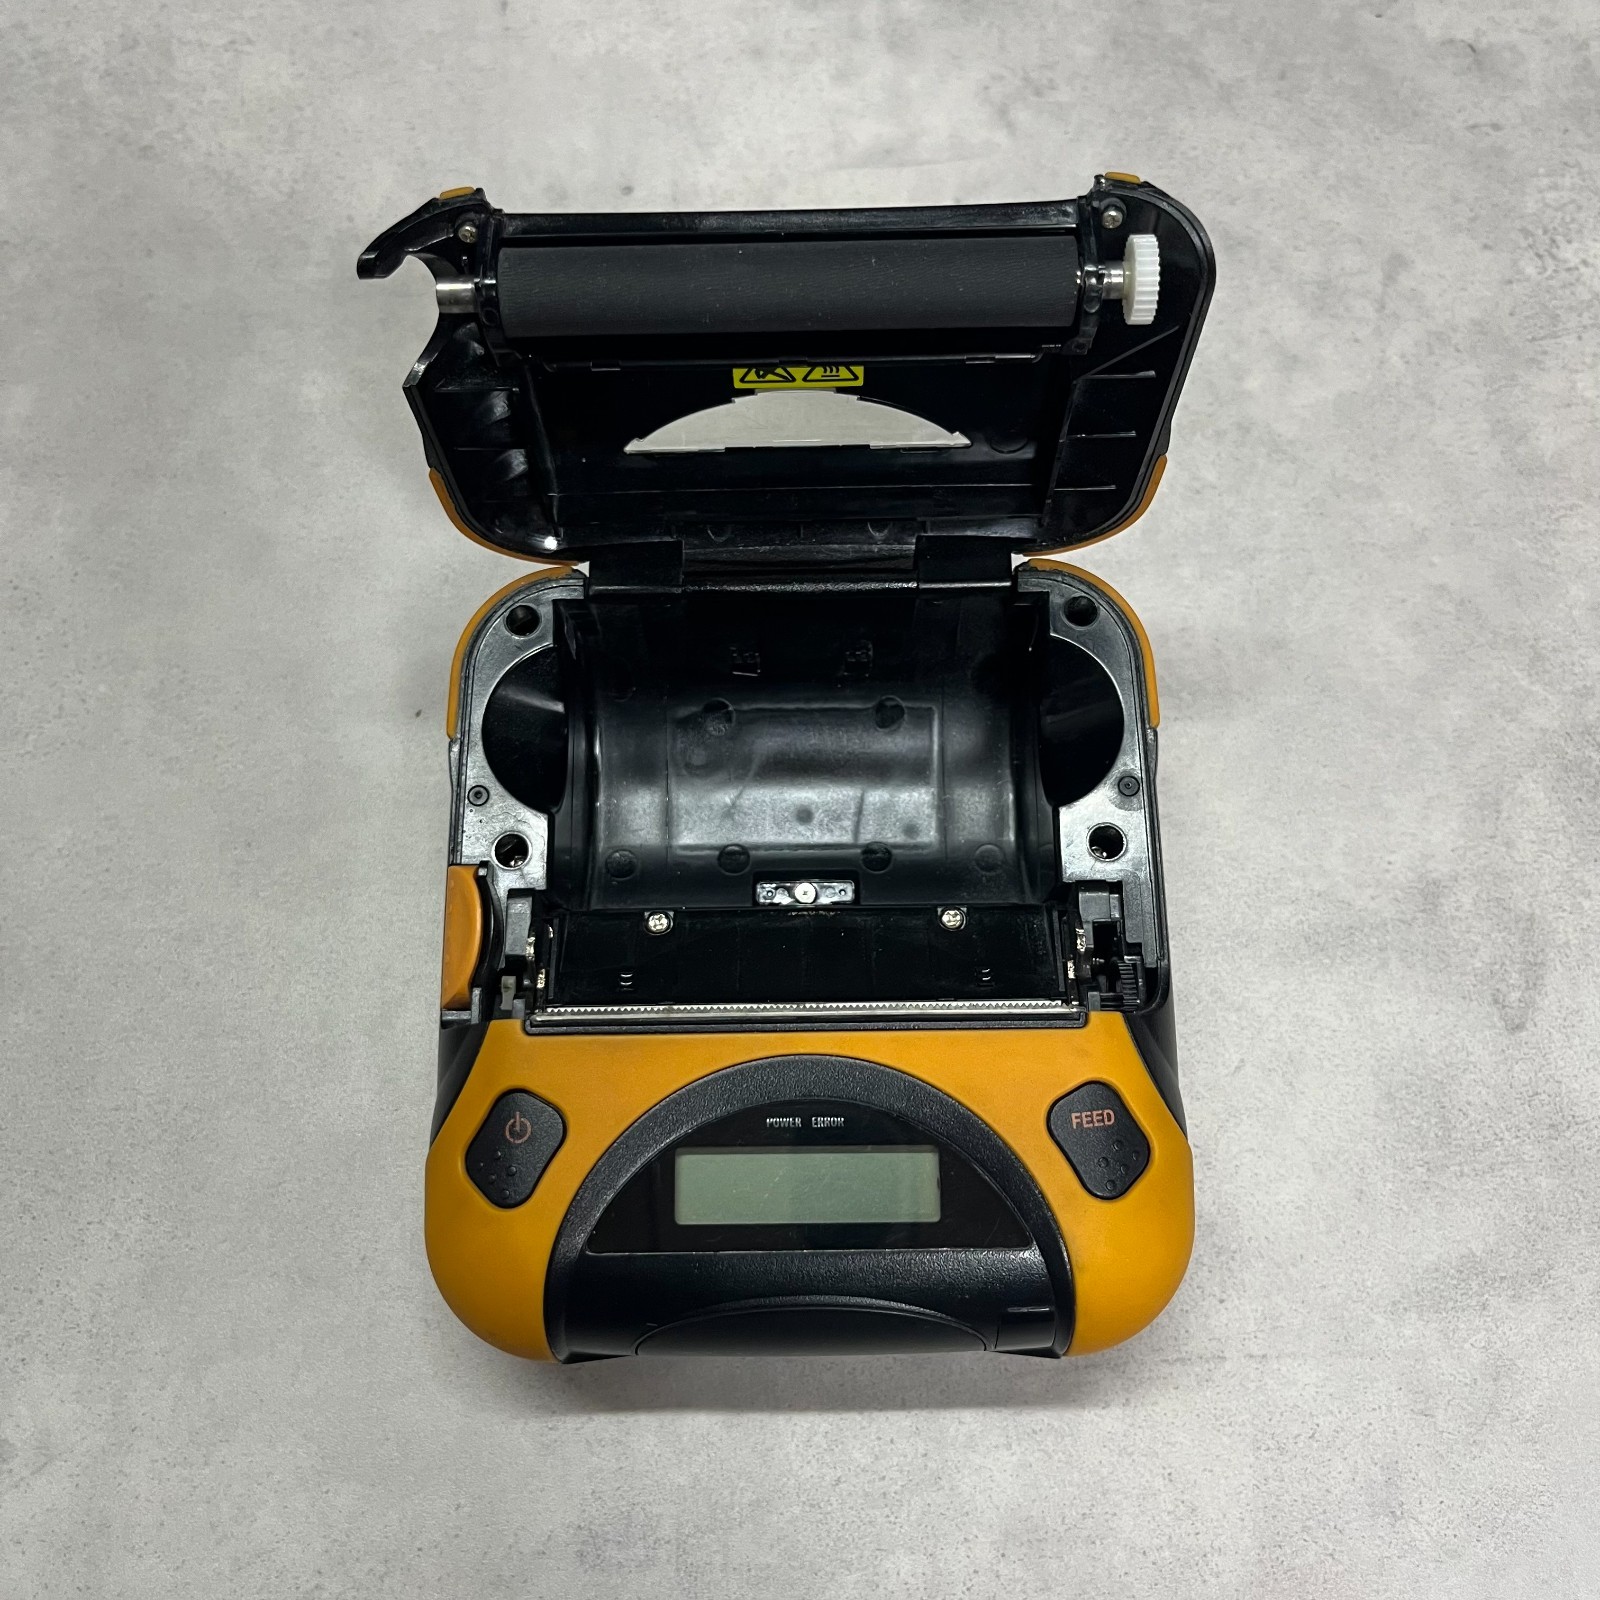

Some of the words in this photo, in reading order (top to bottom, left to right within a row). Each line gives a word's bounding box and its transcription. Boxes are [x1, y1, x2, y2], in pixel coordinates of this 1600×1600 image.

[766, 1116, 802, 1128] POWER
[811, 1116, 845, 1128] ERROR
[1071, 1109, 1115, 1129] FEED
